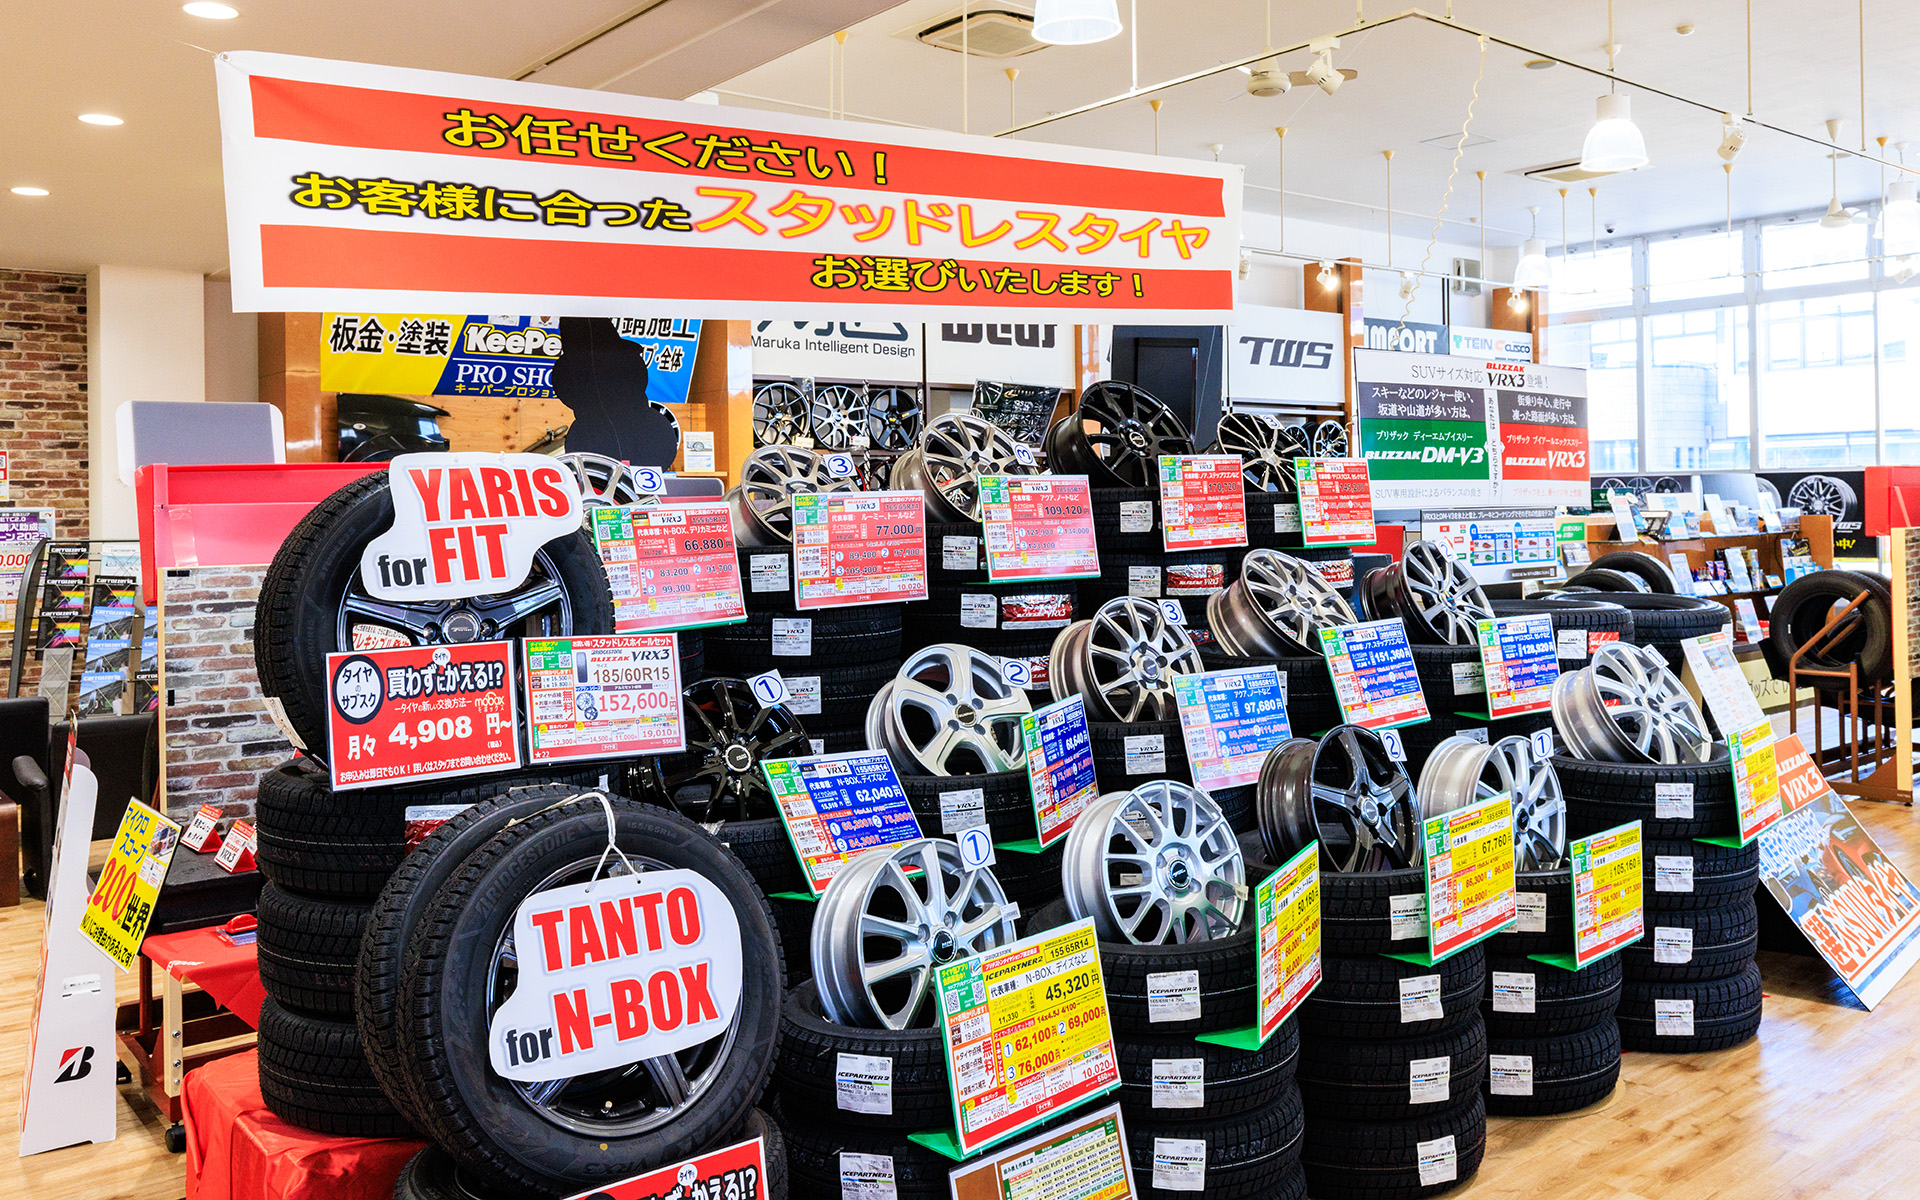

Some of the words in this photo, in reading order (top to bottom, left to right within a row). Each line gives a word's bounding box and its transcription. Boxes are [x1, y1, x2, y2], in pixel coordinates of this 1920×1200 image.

[443, 108, 888, 184] お任せください！
[811, 254, 1145, 297] お選びいたします！
[329, 317, 451, 357] 板金・塗装
[465, 324, 563, 356] KeePe
[751, 336, 801, 350] Maruka
[805, 338, 869, 354] Intelligent
[873, 343, 915, 357] Design
[1463, 335, 1493, 350] TEIN
[1239, 336, 1334, 369] TWS
[456, 363, 506, 384] PRO
[512, 367, 555, 387] SHO
[1486, 362, 1525, 373] BLIZZAK
[1487, 372, 1525, 388] VRX3
[1365, 450, 1421, 461] BLIZZAK
[1421, 447, 1484, 466] DM-V3
[1505, 457, 1546, 467] BLIZZAK
[1547, 450, 1586, 469] VRX3
[408, 467, 570, 521] YARIS
[1208, 482, 1237, 492] 170,720
[1044, 506, 1082, 516] 109,120
[876, 525, 914, 537] 77,000
[377, 555, 427, 587] for
[428, 524, 508, 583] FIT
[685, 539, 724, 552] 66,880
[631, 649, 670, 662] VRX3
[1375, 649, 1405, 663] 151,360
[1522, 643, 1549, 654] 128,920
[341, 667, 373, 684] タイヤ
[593, 667, 669, 683] 185/60R15
[1224, 680, 1242, 688] VRX2
[341, 693, 376, 710] サブスク
[599, 691, 668, 713] 152,600
[1244, 700, 1276, 713] 97,680
[347, 734, 376, 760] 月々
[388, 716, 472, 750] 4,908
[826, 765, 848, 775] VRX2
[855, 786, 893, 803] 62,040
[1781, 766, 1823, 810] VRX3
[957, 801, 977, 809] VRX2
[124, 807, 150, 835] マイクロ
[119, 833, 149, 864] スコープ
[1482, 834, 1507, 854] 67,760
[1614, 858, 1637, 876] 105,160
[93, 857, 136, 921] 200
[121, 893, 150, 941] 世界
[532, 887, 700, 971] TANTO
[986, 955, 1043, 981] ICEPARTNER2
[1046, 972, 1089, 1001] 45,320
[506, 1027, 552, 1066] for
[553, 962, 719, 1055] N-BOX
[1068, 1006, 1101, 1029] 69,000
[1015, 1028, 1051, 1051] 62,100
[1018, 1051, 1055, 1076] 76,000
[838, 1072, 884, 1080] ICEPARTNER
